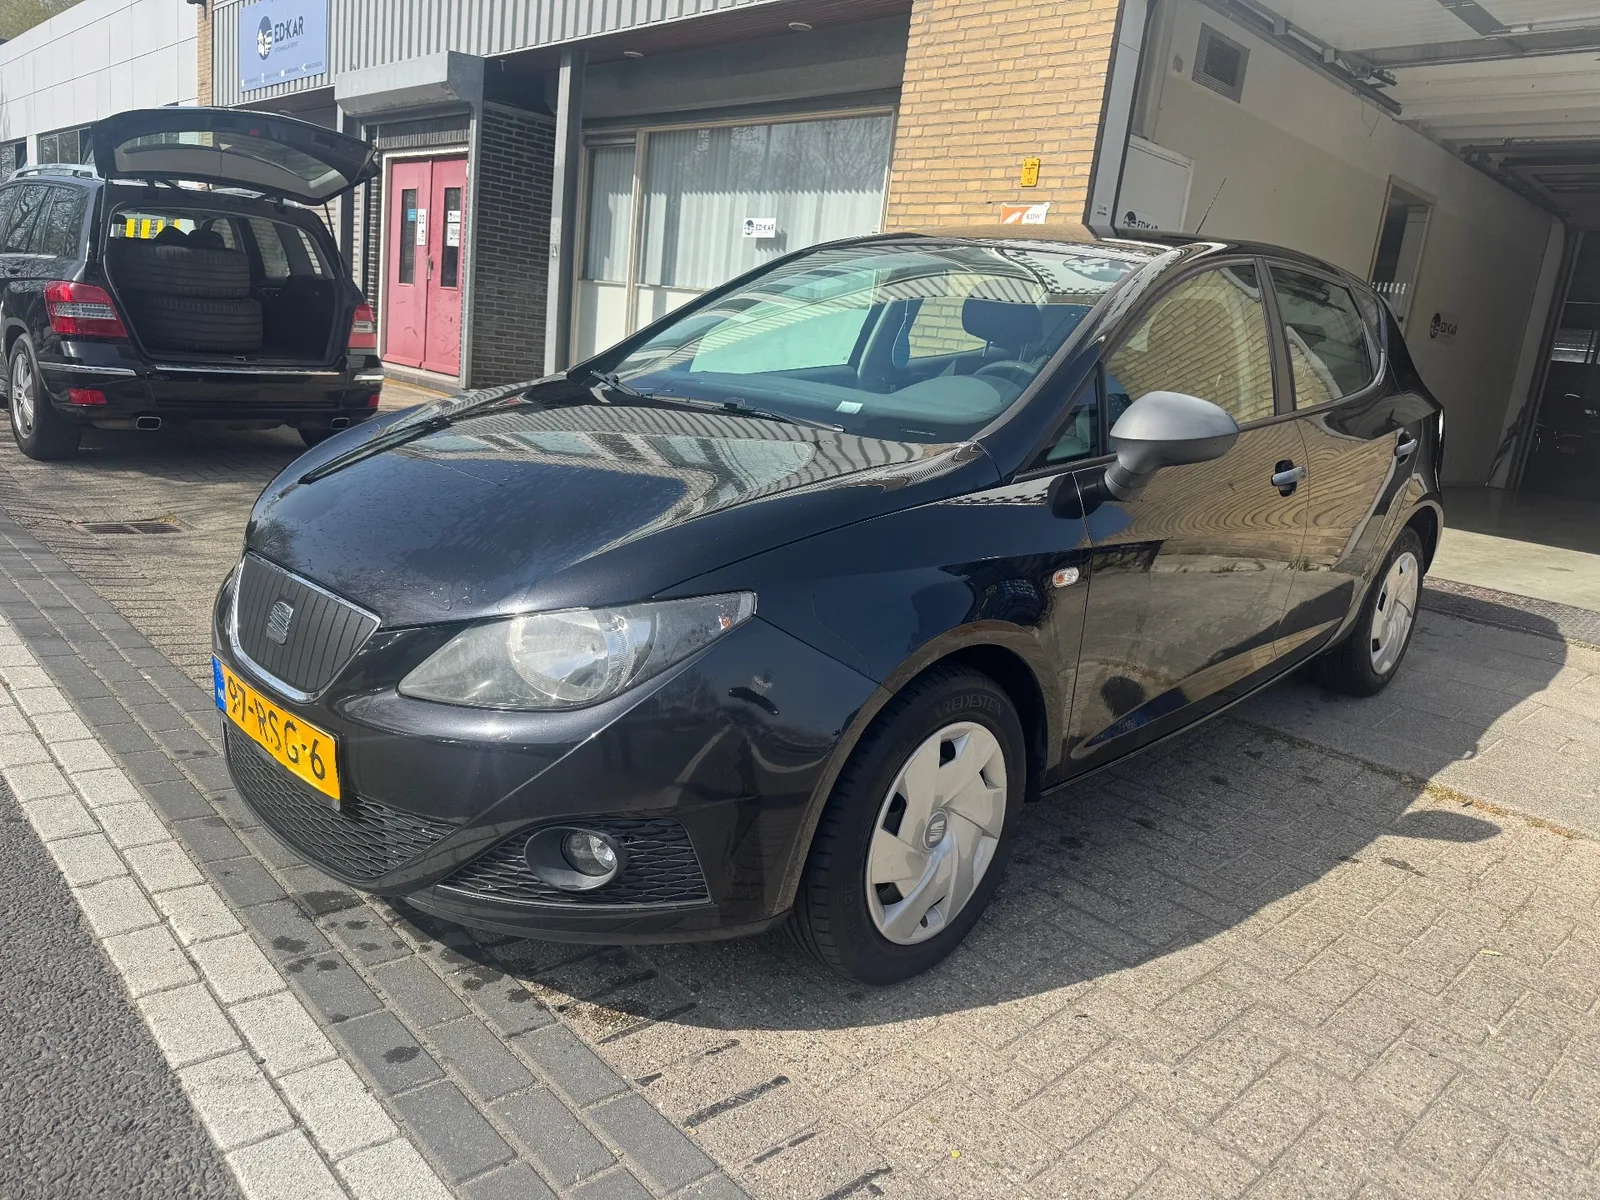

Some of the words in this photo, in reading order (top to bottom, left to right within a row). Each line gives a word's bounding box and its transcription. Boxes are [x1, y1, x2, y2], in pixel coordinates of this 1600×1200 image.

[217, 687, 226, 702] NL
[933, 693, 1004, 718] VREDESTEIN
[227, 676, 326, 781] 97-RSG-6
